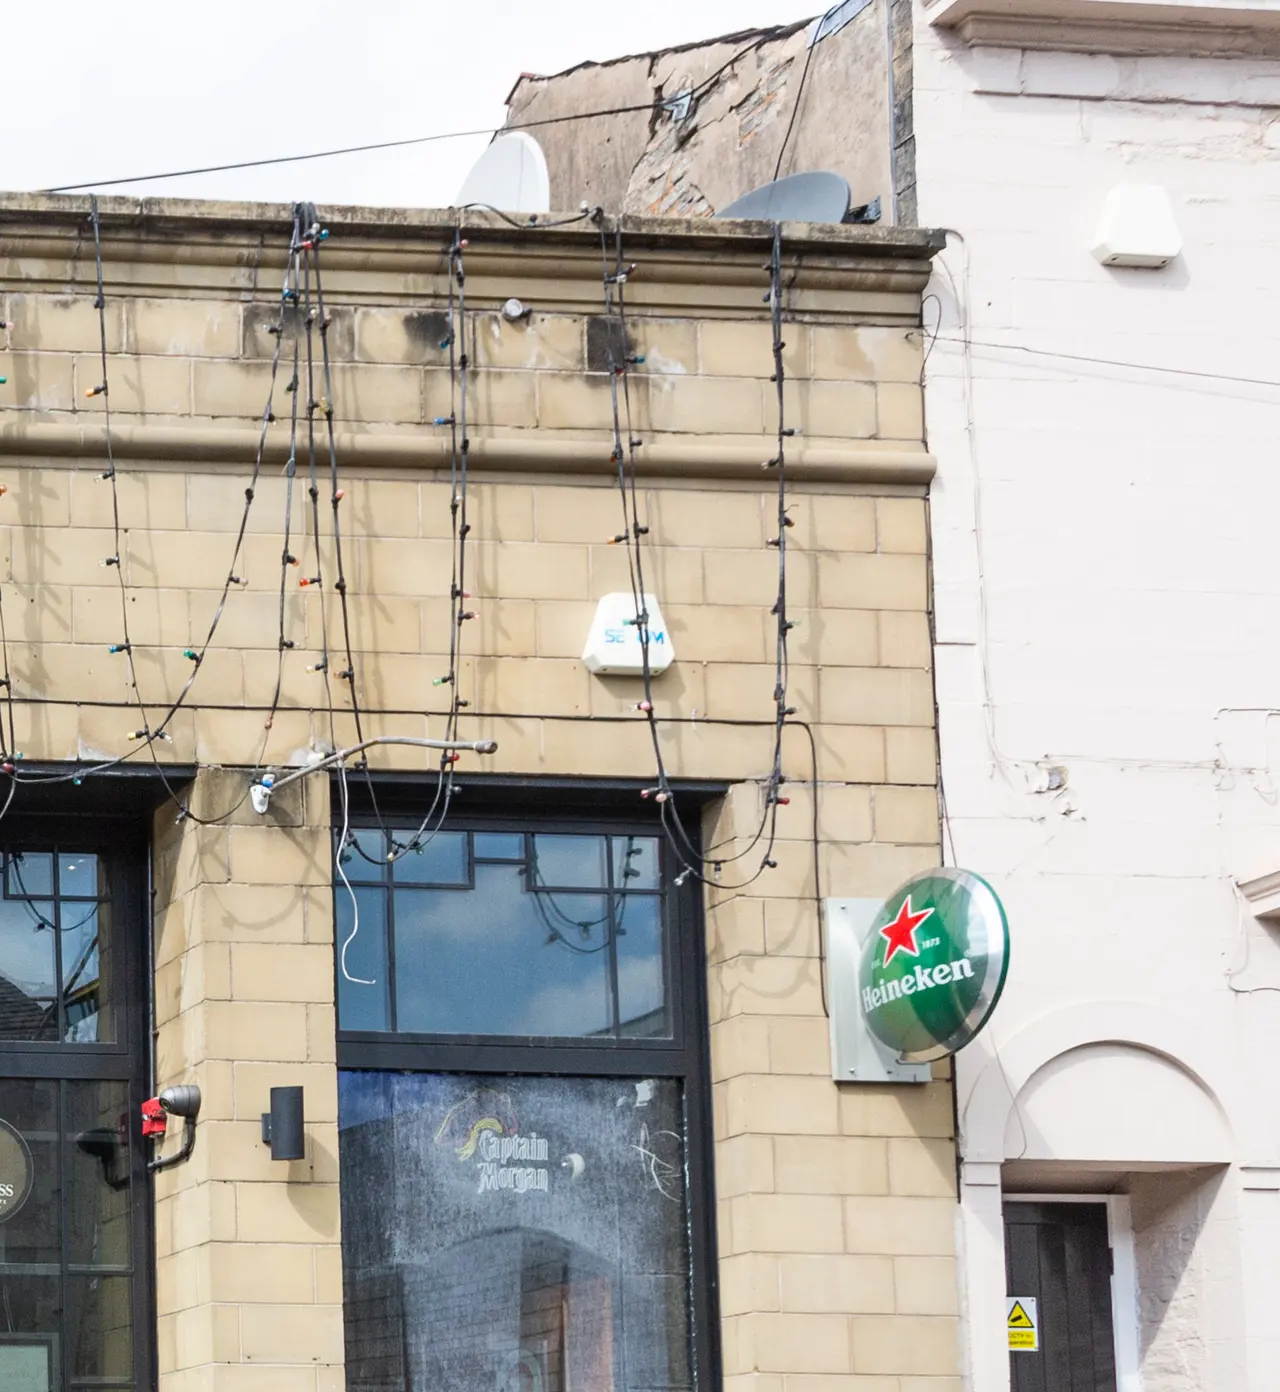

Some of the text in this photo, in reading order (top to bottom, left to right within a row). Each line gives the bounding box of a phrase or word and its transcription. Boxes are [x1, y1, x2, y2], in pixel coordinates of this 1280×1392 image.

[861, 958, 975, 1013] Heineken
[478, 1130, 549, 1165] Captain
[476, 1162, 549, 1194] Morgan
